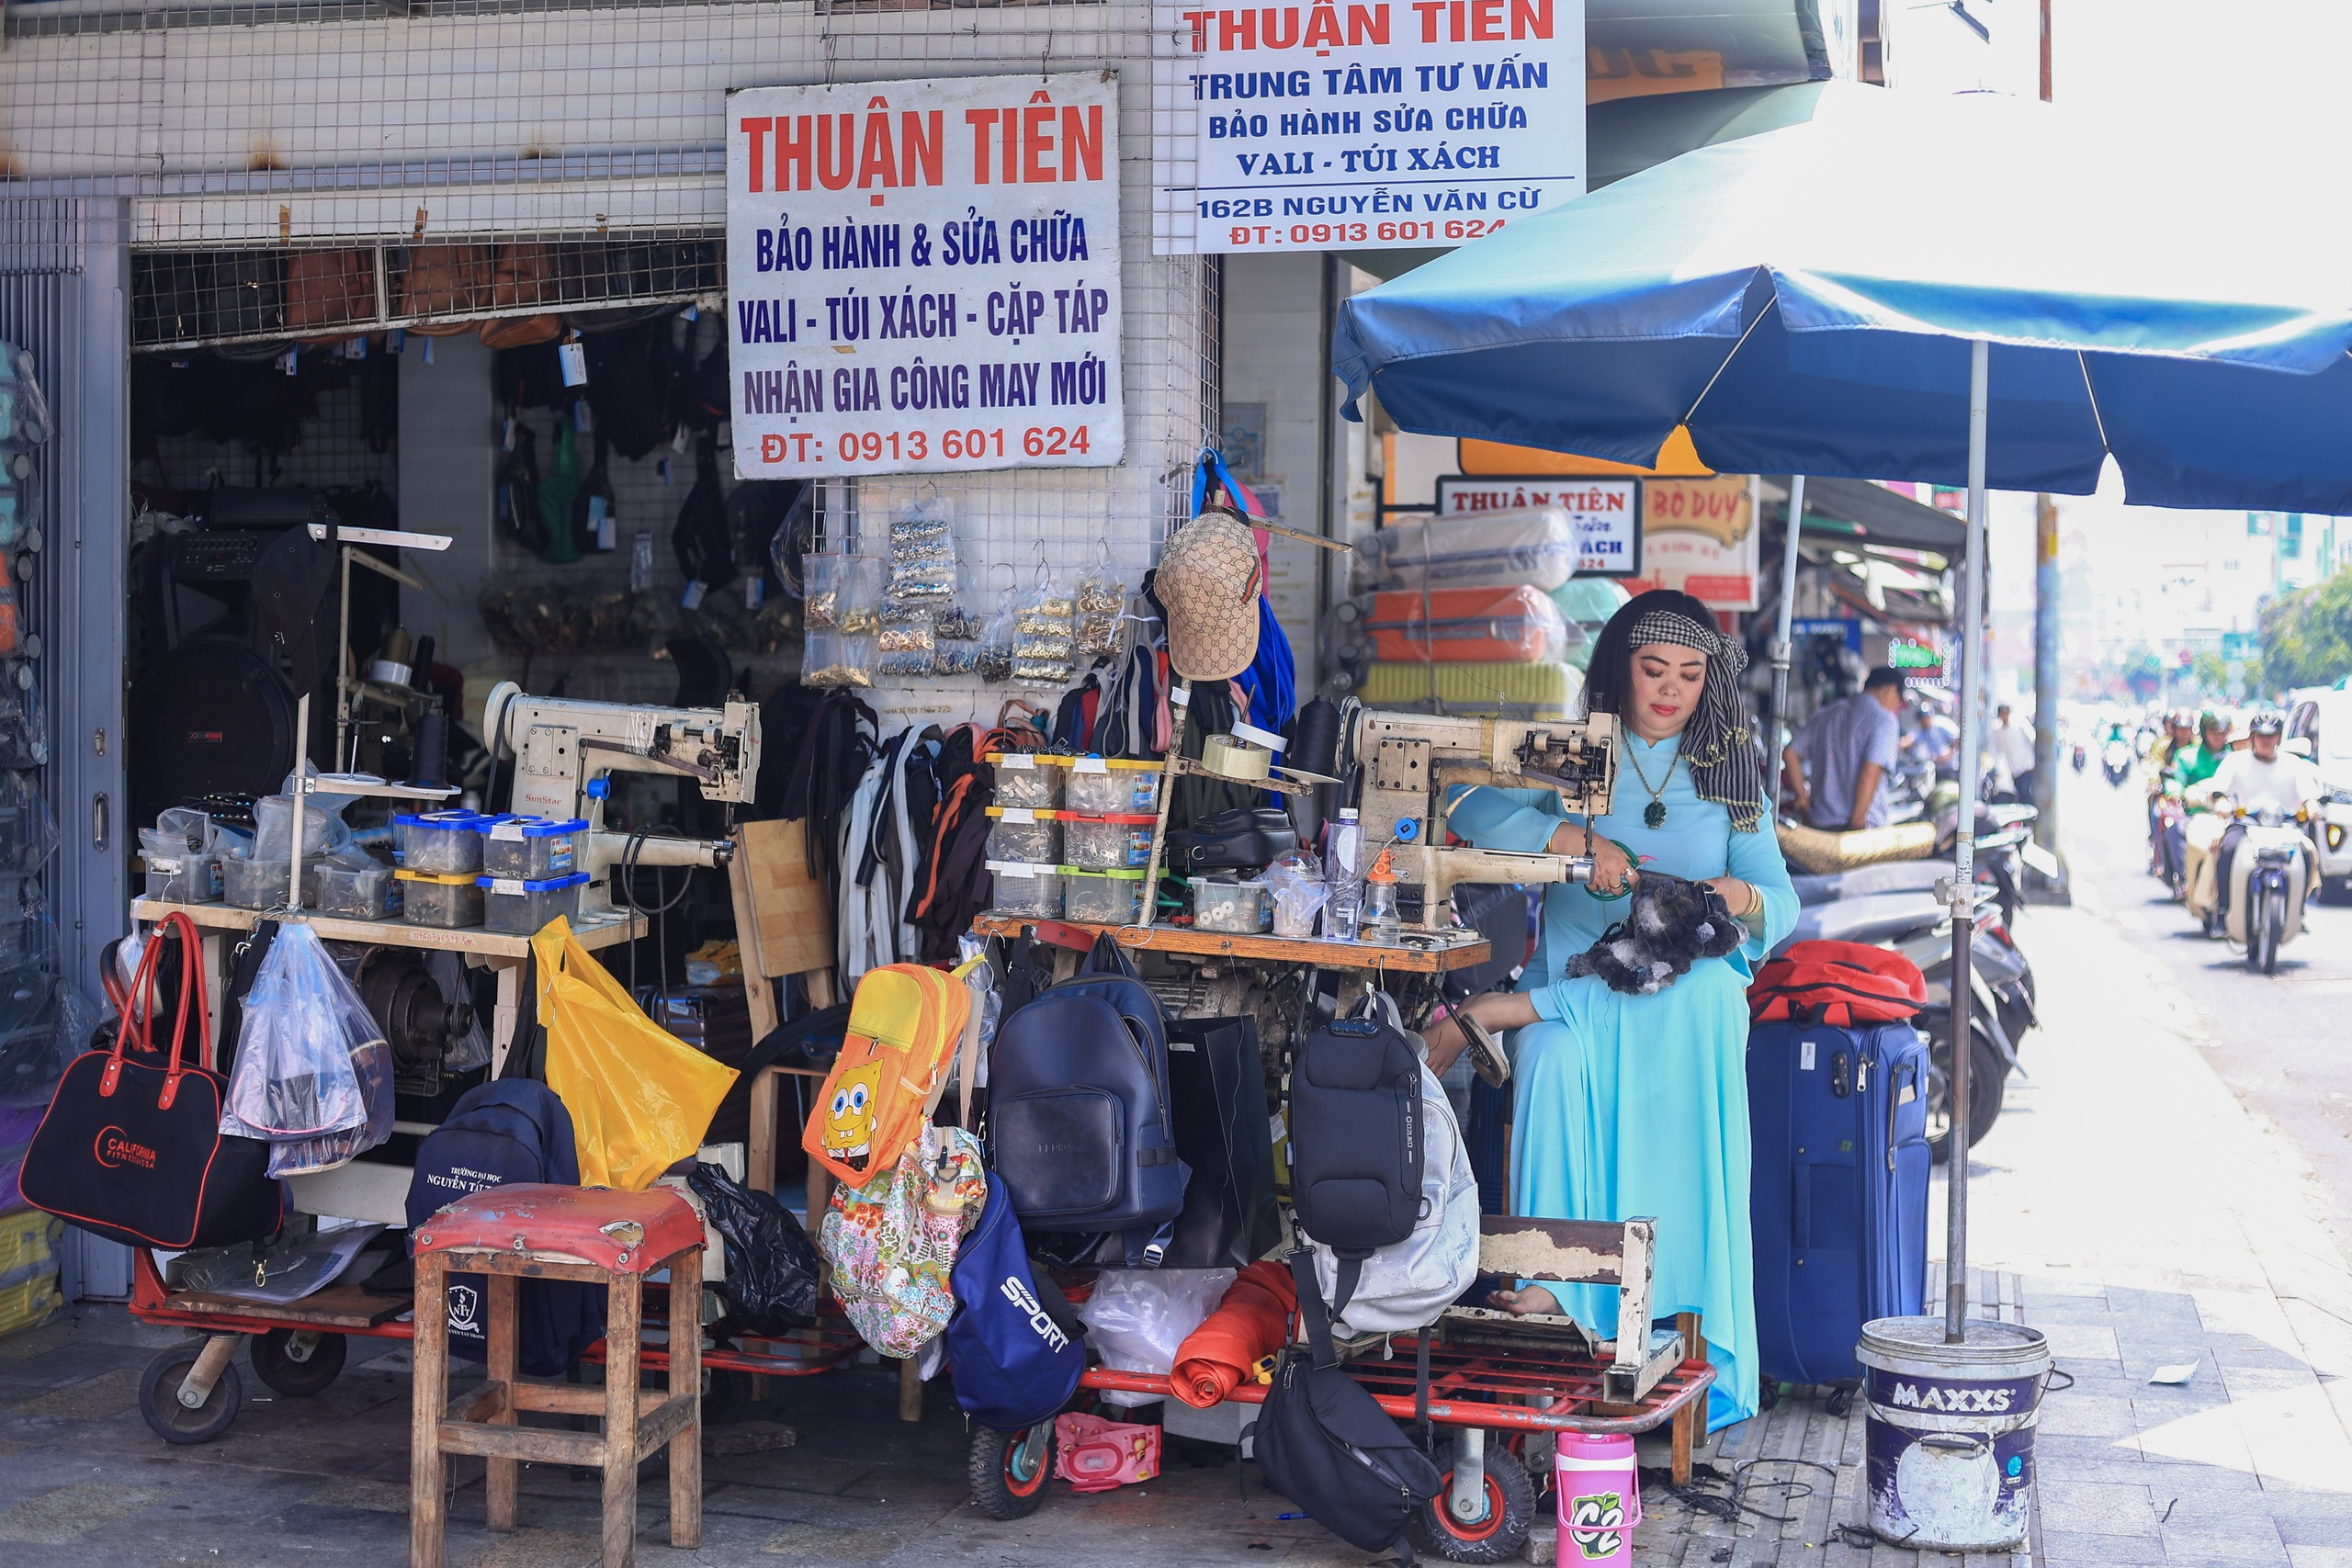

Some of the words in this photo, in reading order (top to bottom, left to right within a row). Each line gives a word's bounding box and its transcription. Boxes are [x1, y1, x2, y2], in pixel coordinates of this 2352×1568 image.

[1183, 0, 1390, 57] THUẬN
[1189, 71, 1310, 100] TRUNG
[1323, 62, 1402, 95] TÂM
[1415, 62, 1464, 92] TƯ
[1473, 53, 1548, 90] VẤN
[1209, 108, 1268, 139] BẢO
[1281, 108, 1361, 136] HÀNH
[1374, 103, 1433, 132] SỬA
[1445, 101, 1527, 130] CHỮA
[741, 96, 944, 206] THUẬN
[965, 90, 1103, 185] TIÊN
[1236, 152, 1314, 175] VALI
[1340, 143, 1397, 172] TÚI
[1408, 141, 1500, 171] XÁCH
[1196, 199, 1273, 219] 162B
[1283, 186, 1412, 216] NGUYỄN
[1423, 188, 1487, 211] VĂN
[1498, 186, 1543, 209] CỪ
[756, 213, 812, 272] BẢO
[822, 217, 900, 270] HÀNH
[910, 223, 932, 266] &
[943, 206, 1001, 265] SỬA
[1011, 209, 1089, 263] CHỮA
[1229, 226, 1283, 244] ĐT:
[1290, 223, 1368, 243] 0913
[1378, 221, 1434, 241] 601
[739, 299, 796, 344] VALI
[826, 288, 869, 342] TÚI
[879, 286, 956, 339] XÁCH
[987, 282, 1045, 345] CẶP
[1054, 279, 1108, 333] TÁP
[744, 360, 823, 423] NHẬN
[833, 367, 881, 412] GIA
[890, 356, 969, 411] CÔNG
[979, 363, 1040, 408] MAY
[1051, 351, 1106, 405] MỚI
[761, 434, 822, 464] ĐT:
[838, 432, 928, 461] 0913
[942, 428, 1004, 458] 601
[1023, 425, 1091, 456] 624
[1558, 487, 1625, 512] TIÊN
[1691, 490, 1739, 523] DUY
[525, 794, 562, 806] SunStar
[107, 1138, 156, 1161] CALIFORNIA
[426, 1174, 467, 1190] NGUYỄN
[1000, 1276, 1069, 1354] SPORT
[1892, 1382, 2010, 1412] MAXXS
[1573, 1502, 1623, 1553] C2
